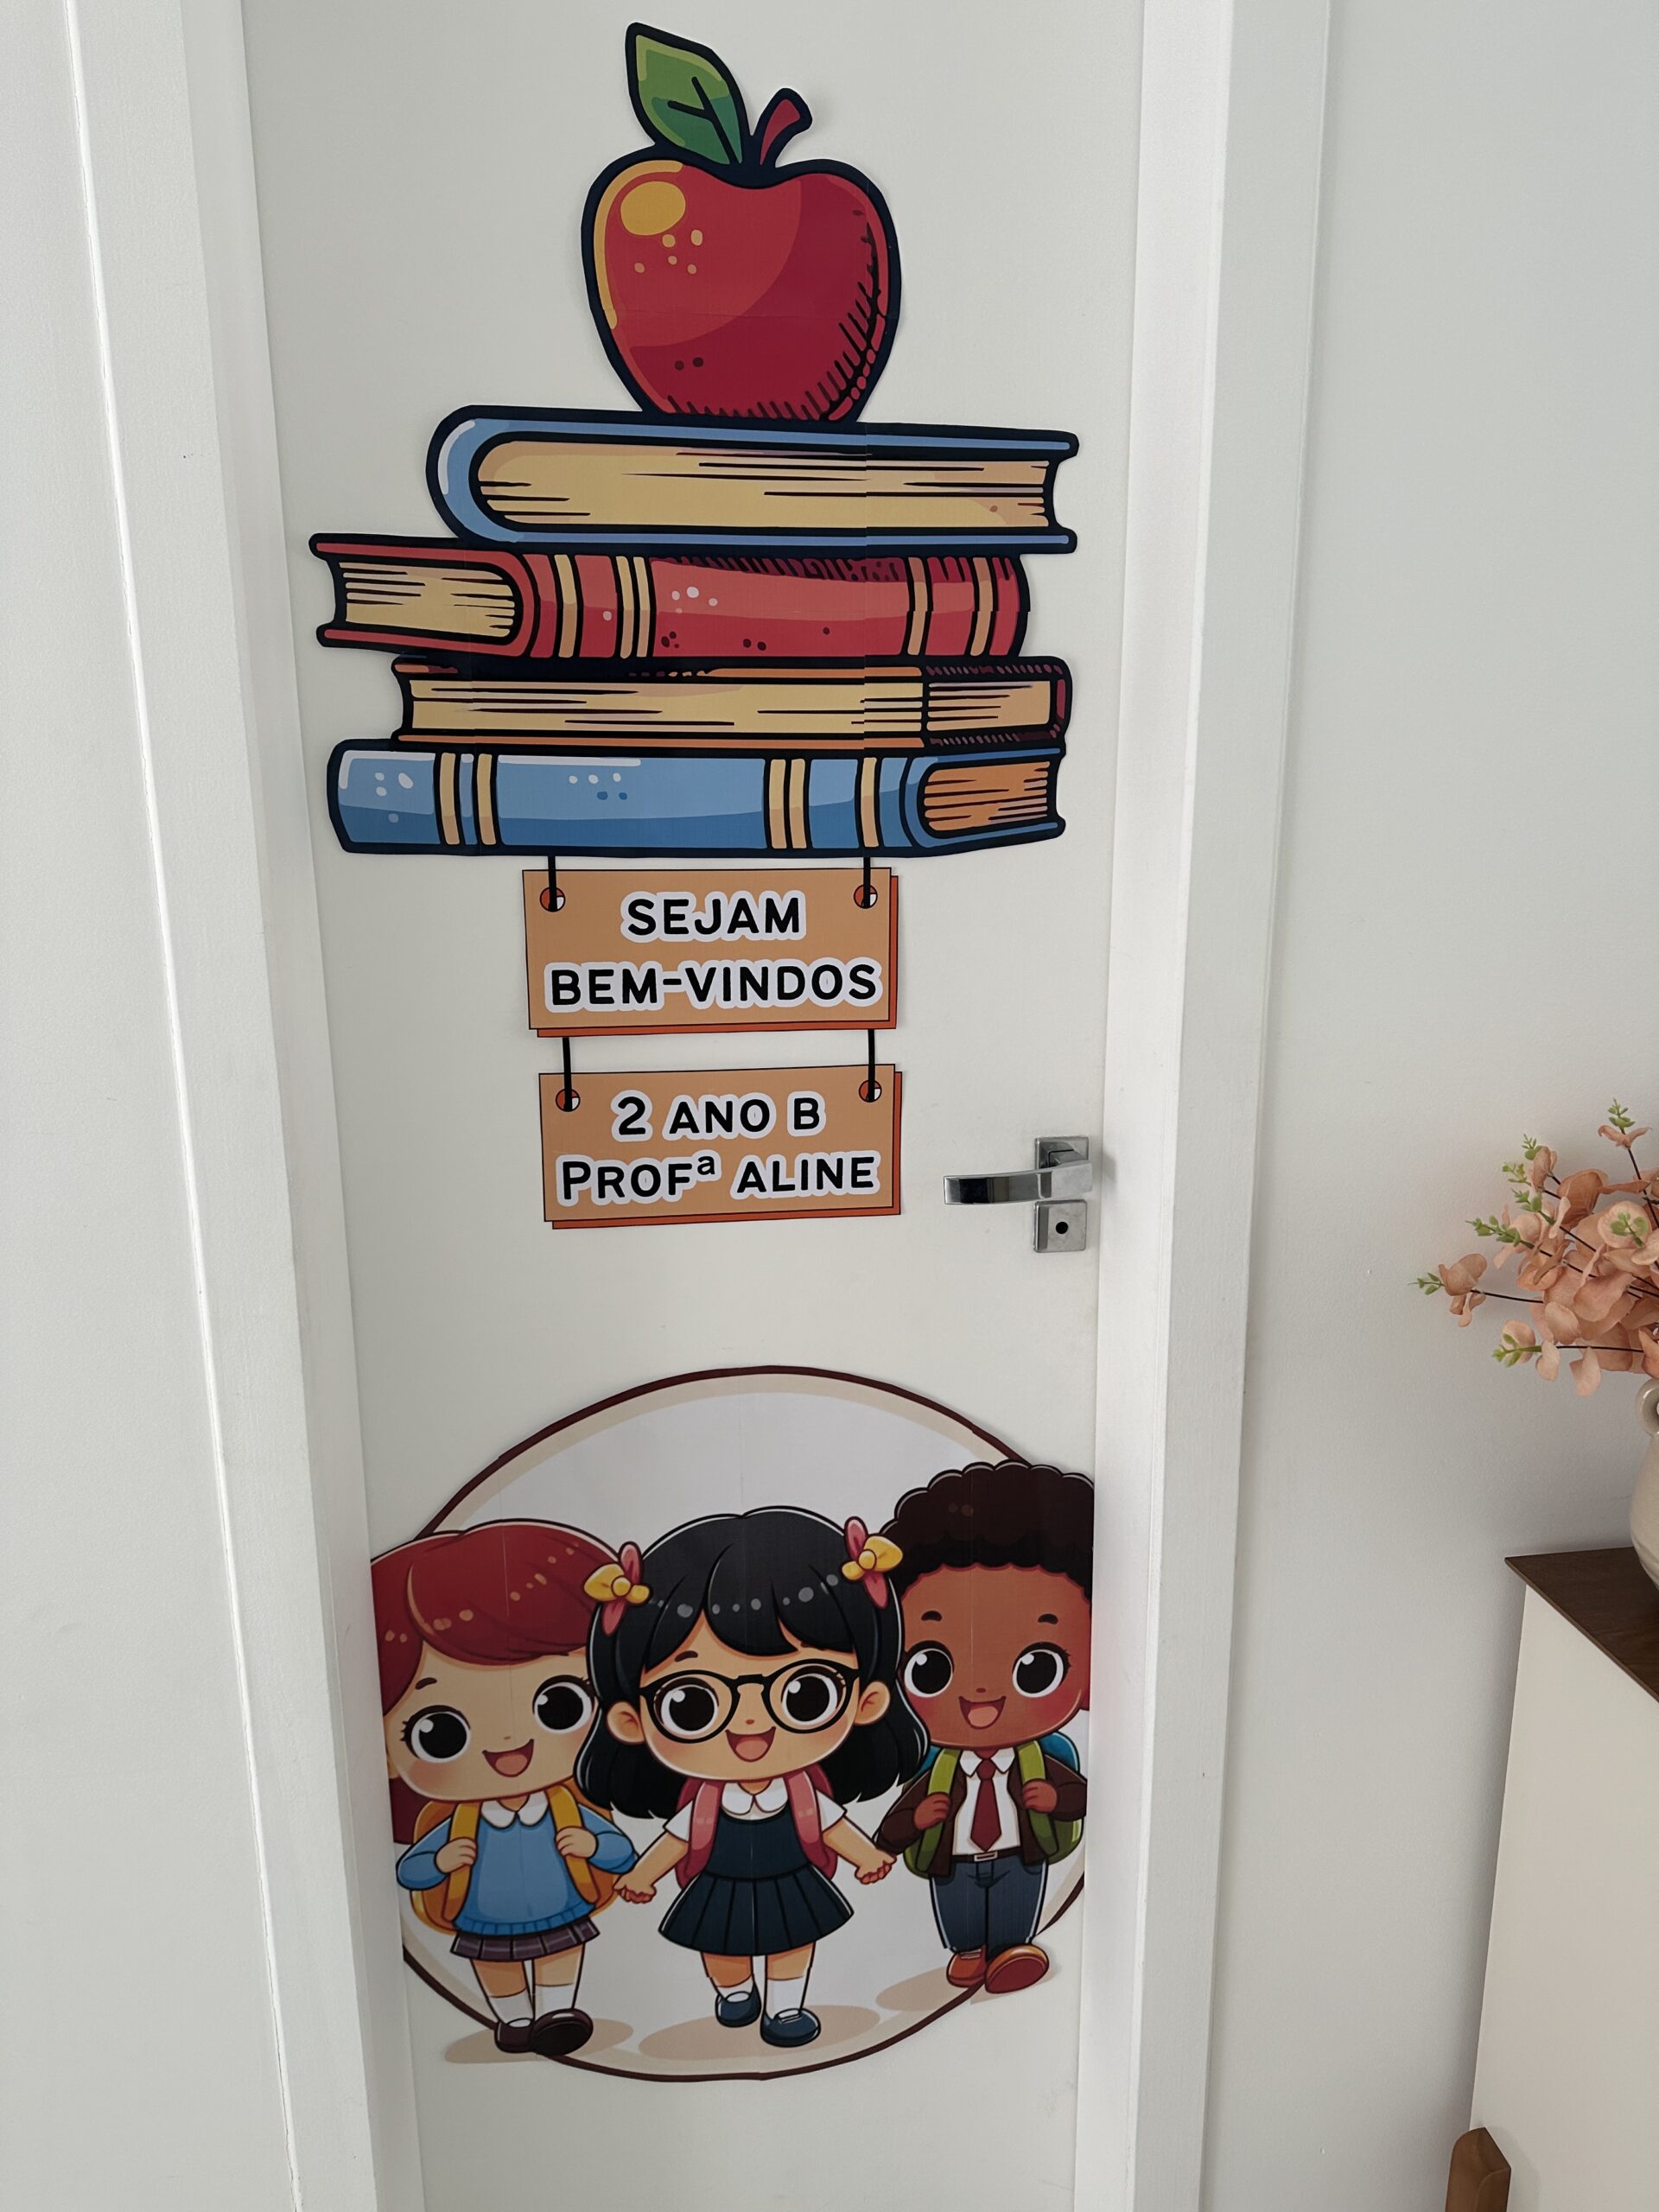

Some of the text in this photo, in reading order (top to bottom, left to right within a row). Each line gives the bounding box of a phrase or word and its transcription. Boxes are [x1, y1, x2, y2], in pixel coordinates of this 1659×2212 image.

[627, 897, 800, 936] SEJAM
[550, 964, 877, 1006] BEM-VINDOS
[617, 1096, 820, 1136] 2 ANO B
[736, 1156, 874, 1194] ALINE
